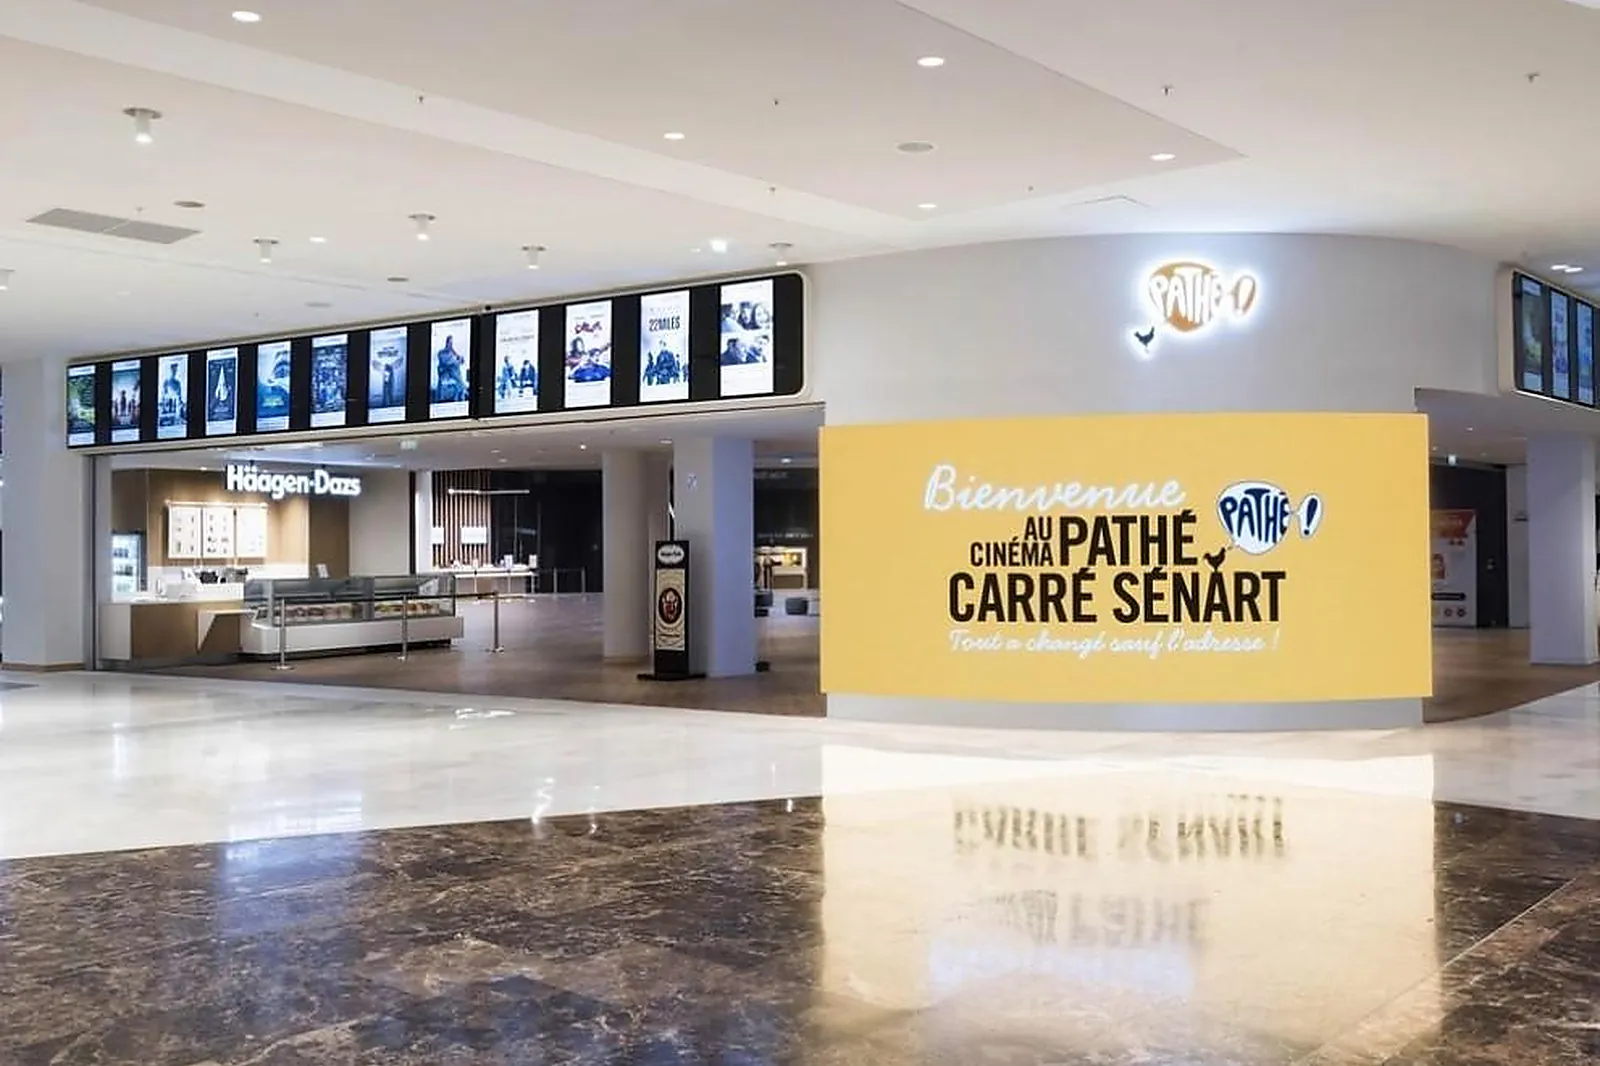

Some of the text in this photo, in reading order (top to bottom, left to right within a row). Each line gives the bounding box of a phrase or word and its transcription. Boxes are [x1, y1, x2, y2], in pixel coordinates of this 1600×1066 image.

[226, 464, 362, 500] Häagen-Dazs
[923, 463, 1186, 513] Bienvenue
[970, 509, 1197, 567] CINÉMA PATHÉ
[1024, 516, 1052, 541] AU
[948, 566, 1287, 623] CARRÉ SÉNART
[948, 629, 1002, 652] Tout
[1005, 640, 1022, 652] a
[1025, 629, 1107, 660] changé
[1109, 629, 1165, 660] sauf
[1167, 628, 1266, 652] l'adresse
